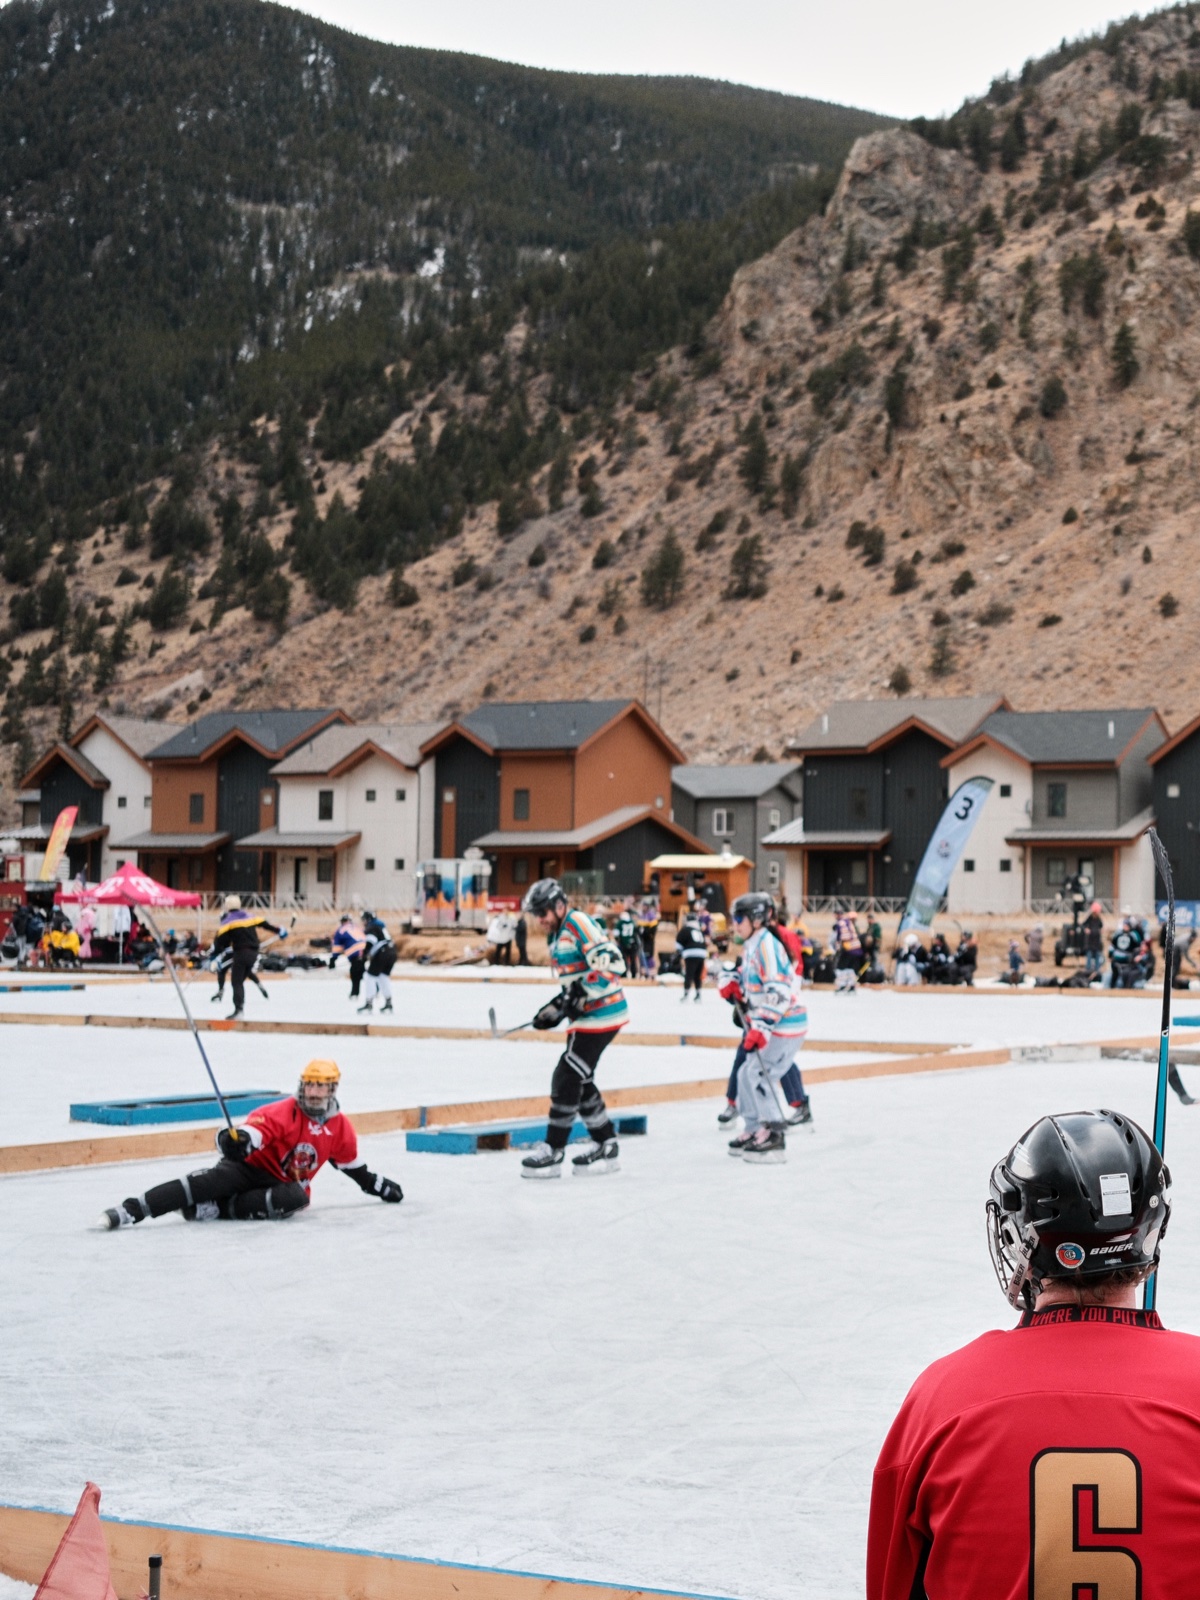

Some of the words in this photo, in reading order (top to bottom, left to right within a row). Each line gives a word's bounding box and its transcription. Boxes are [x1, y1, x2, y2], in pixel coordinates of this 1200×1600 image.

[954, 797, 973, 820] 3
[1089, 1242, 1134, 1256] BAUER
[1013, 1264, 1025, 1286] BAUER
[1030, 1307, 1073, 1326] WHERE
[1080, 1307, 1107, 1322] YOU
[1113, 1308, 1138, 1326] PUT
[1028, 1447, 1142, 1600] 6
